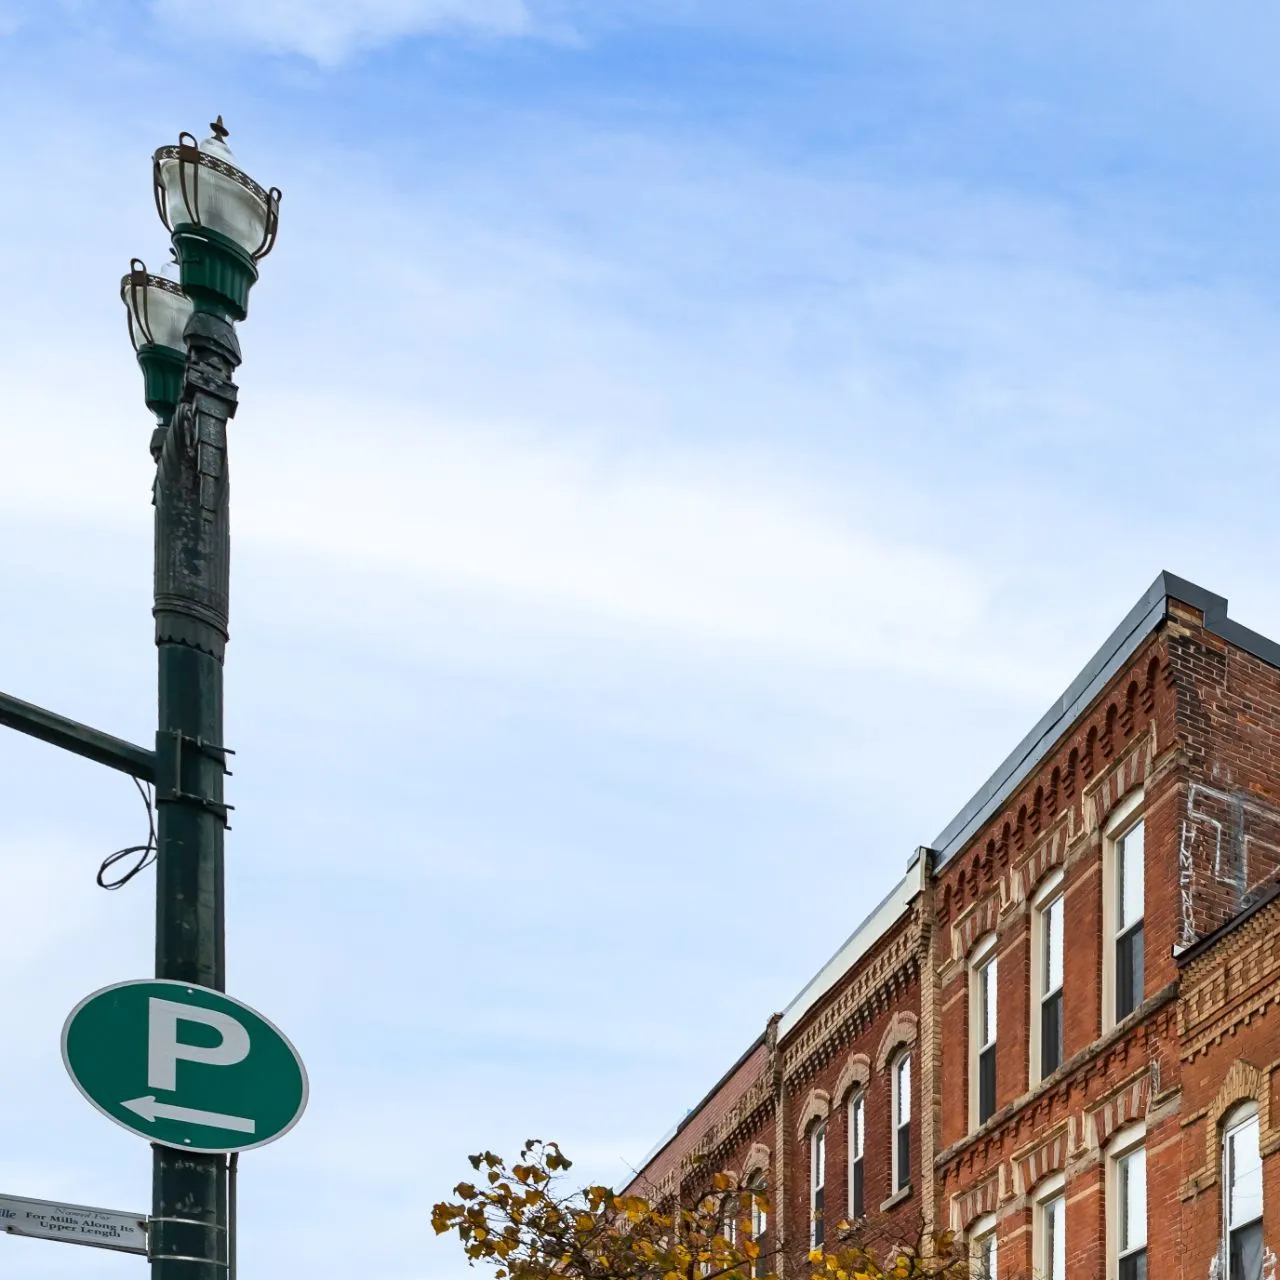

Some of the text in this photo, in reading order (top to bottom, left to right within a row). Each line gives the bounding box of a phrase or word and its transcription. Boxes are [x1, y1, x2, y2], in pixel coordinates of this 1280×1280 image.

[147, 997, 251, 1092] P
[25, 1211, 135, 1233] For Mills Along Its
[40, 1220, 121, 1238] Upper Length
